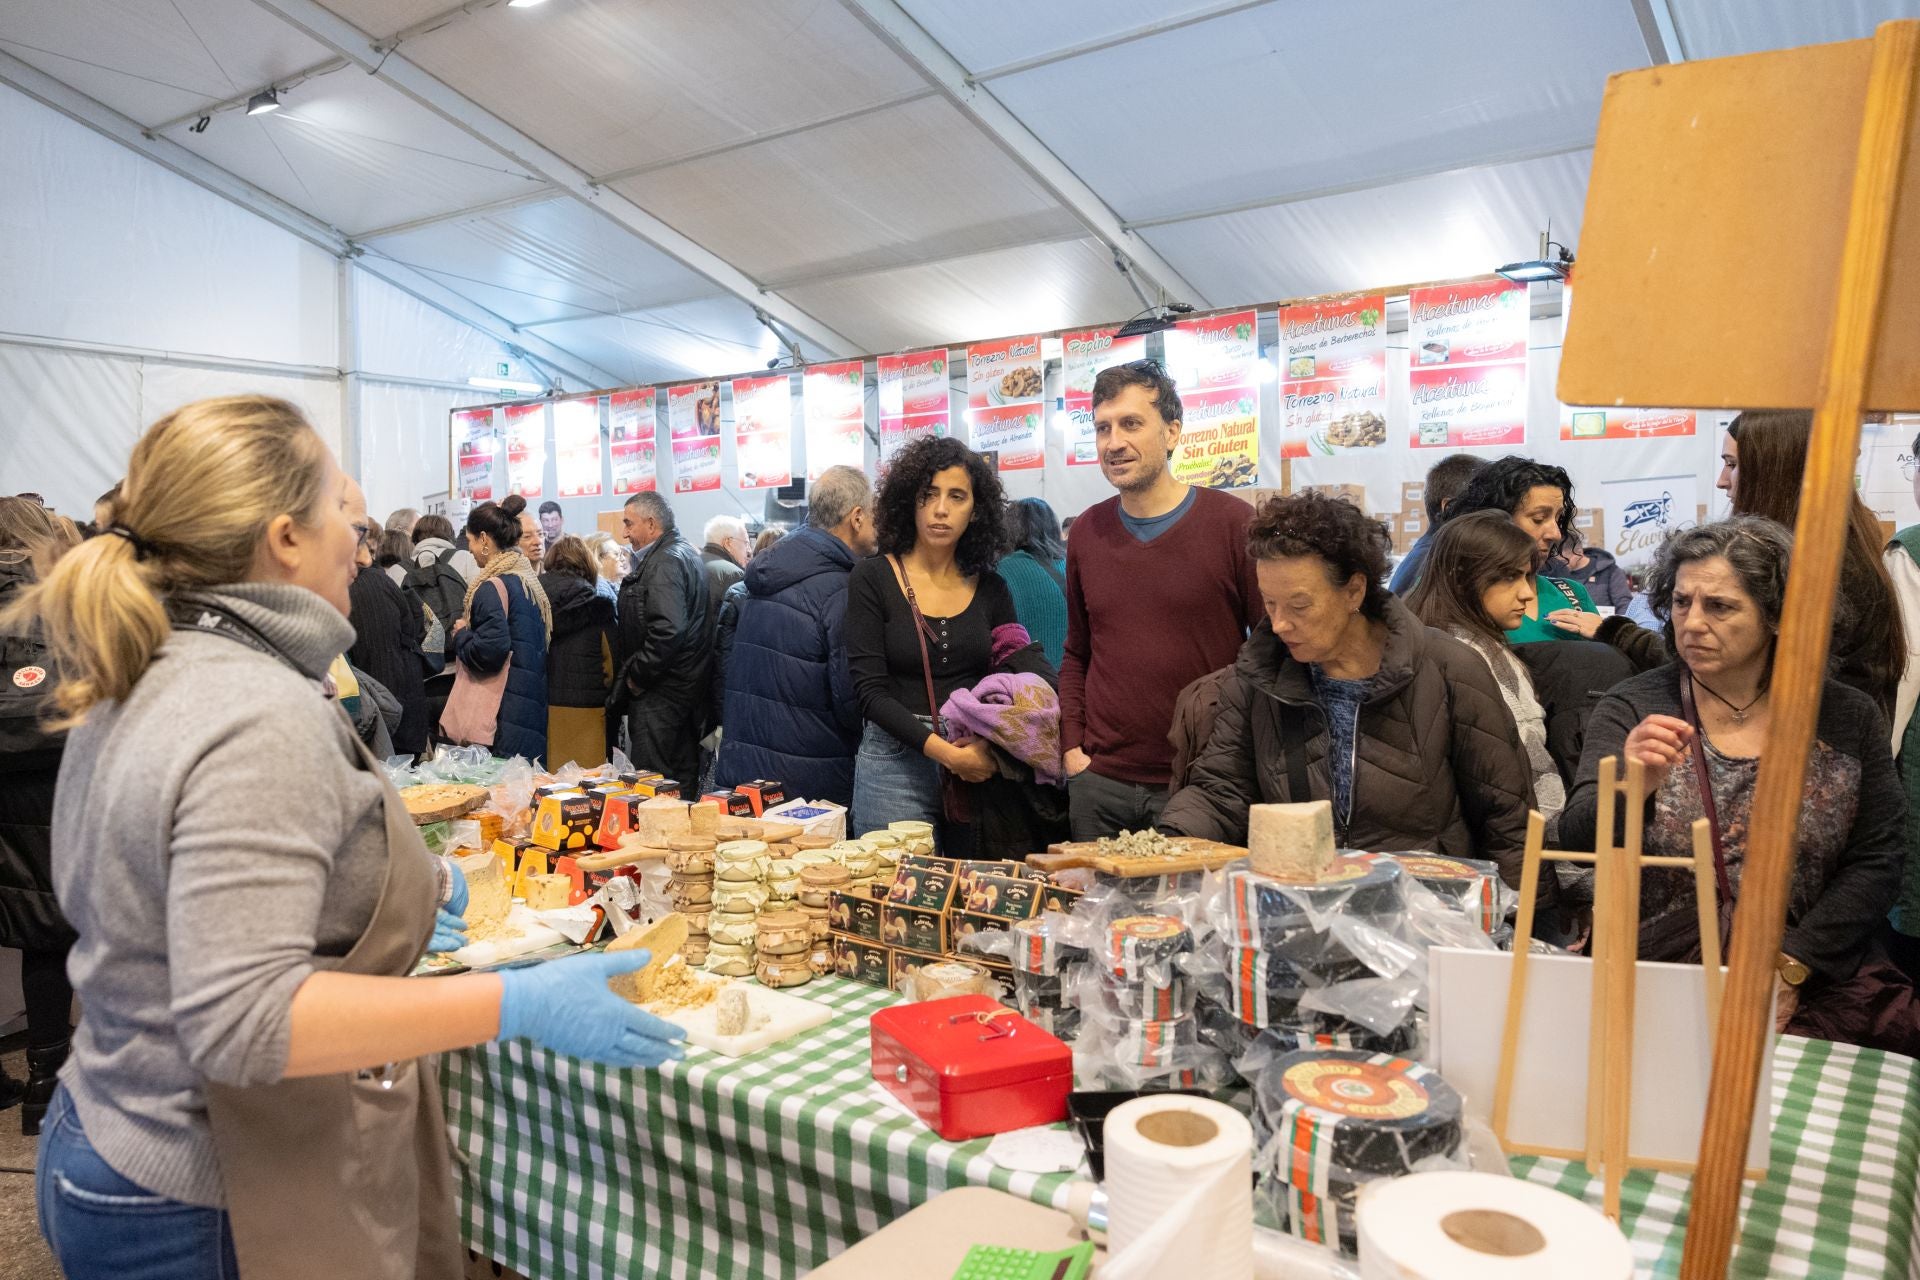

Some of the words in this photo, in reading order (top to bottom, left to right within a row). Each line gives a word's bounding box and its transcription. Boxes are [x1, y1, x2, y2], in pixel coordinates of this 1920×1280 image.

[1413, 292, 1497, 323] Aceitunas
[1196, 324, 1233, 344] itunas
[1283, 311, 1357, 340] Aceitunas
[971, 350, 1005, 367] Torrezno
[1009, 336, 1038, 359] Natural
[1068, 333, 1112, 354] Pepino
[1289, 341, 1317, 355] Rellenas
[1319, 337, 1327, 347] de
[1331, 328, 1376, 346] Berberechos
[880, 360, 929, 383] Aceitunas
[972, 370, 984, 382] Sin
[985, 368, 1005, 382] gluten
[1286, 392, 1335, 410] Torrezno
[1341, 383, 1378, 401] Natural
[1183, 397, 1235, 421] ceitunas
[972, 415, 1024, 438] Aceitunas
[1180, 430, 1217, 446] orrezno
[1221, 418, 1255, 438] Natural
[1182, 445, 1205, 460] Sin
[1207, 439, 1248, 457] Gluten
[1006, 887, 1029, 898] Cabrales
[914, 919, 934, 929] Cabrales
